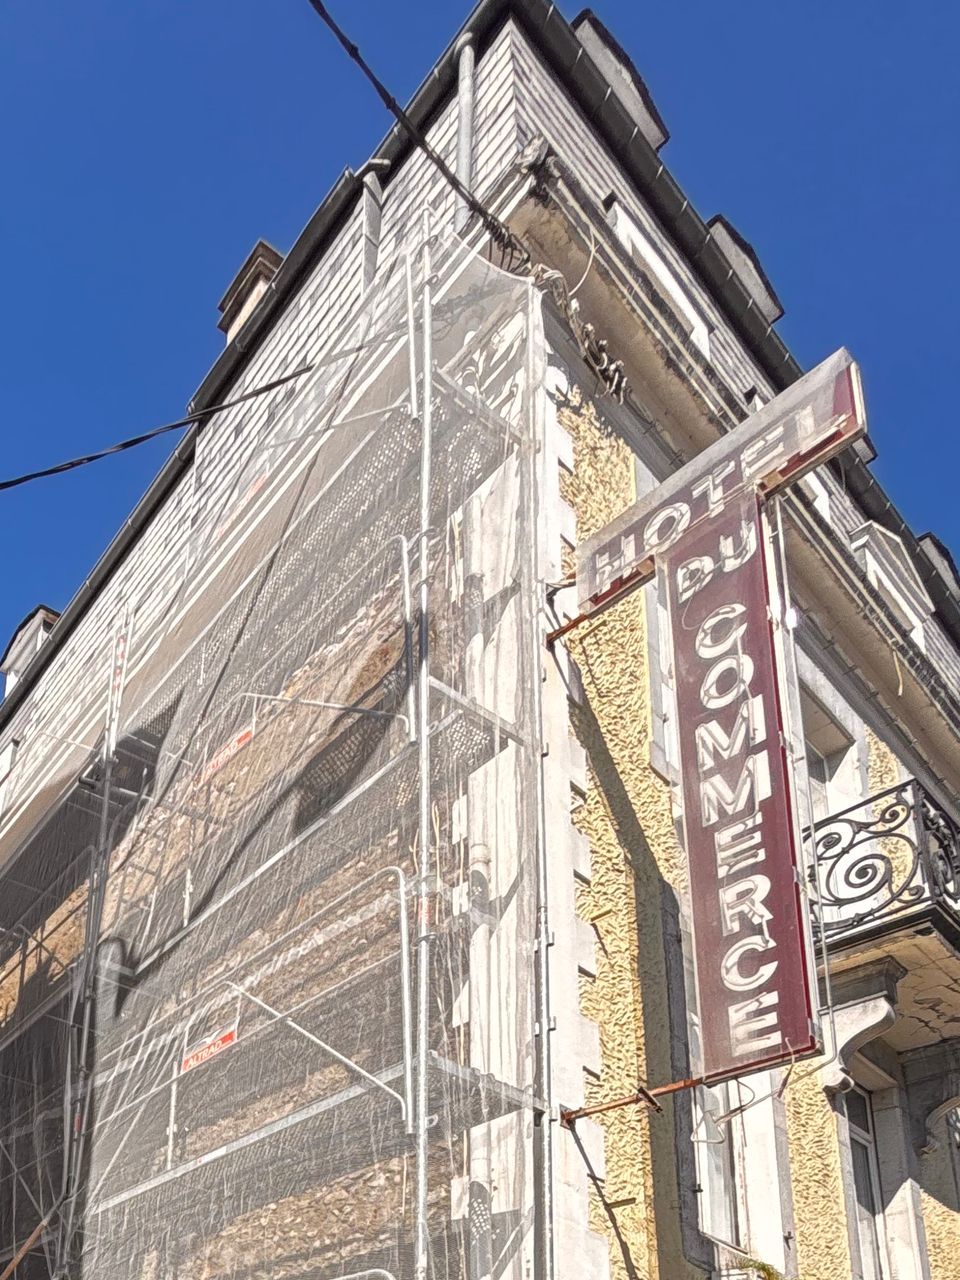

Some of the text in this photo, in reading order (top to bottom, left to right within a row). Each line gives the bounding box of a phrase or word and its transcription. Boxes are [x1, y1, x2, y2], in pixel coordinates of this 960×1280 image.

[593, 405, 847, 598] HOTEL
[676, 519, 758, 604] DU
[695, 602, 783, 1058] COMMERCE
